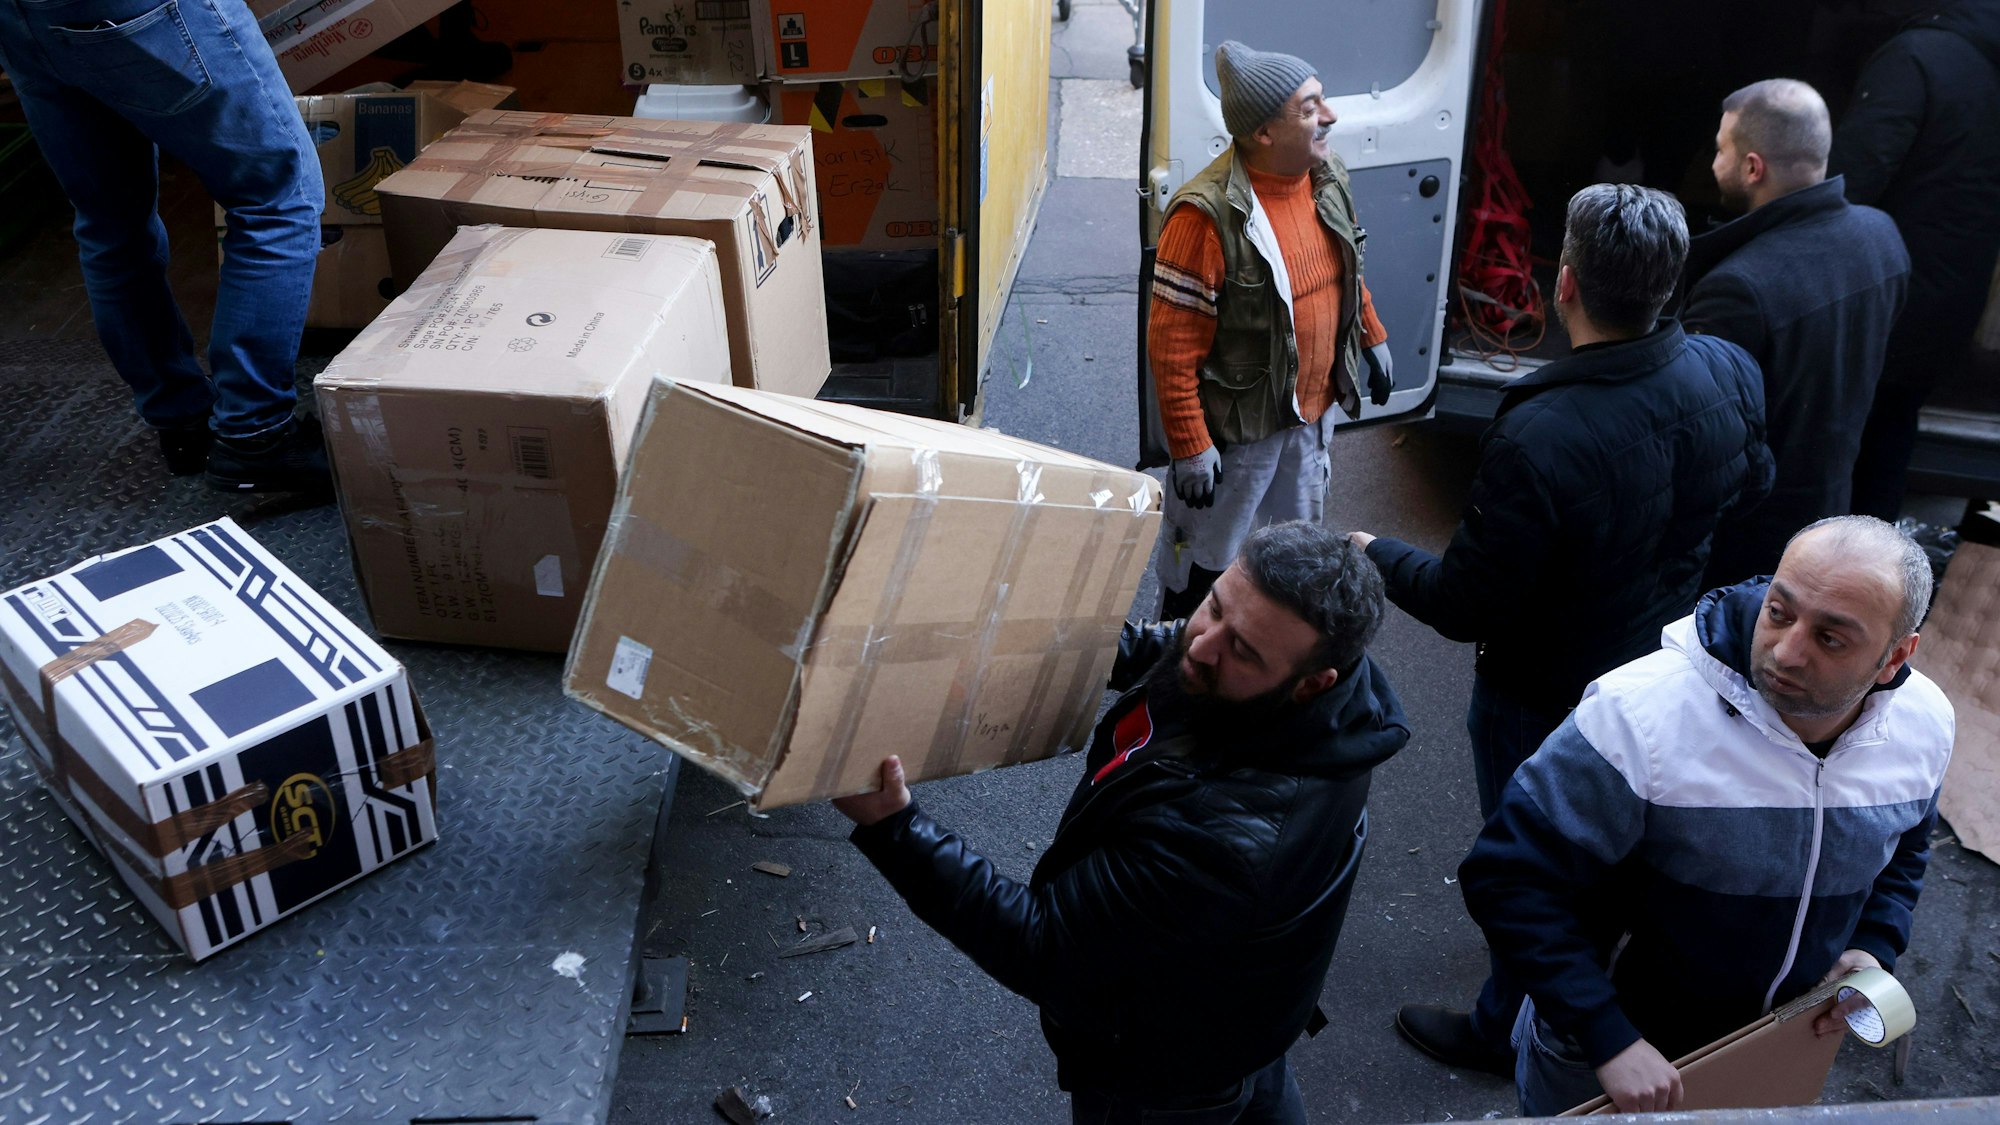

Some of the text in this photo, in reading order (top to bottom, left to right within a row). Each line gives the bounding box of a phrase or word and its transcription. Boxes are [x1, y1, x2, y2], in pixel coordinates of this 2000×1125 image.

[358, 103, 413, 115] Bananas
[885, 220, 938, 239] OB
[413, 330, 435, 350] Sage
[445, 332, 467, 352] QTY:
[464, 313, 480, 325] PC
[566, 338, 587, 358] Made
[584, 311, 605, 332] China
[429, 338, 445, 350] SN
